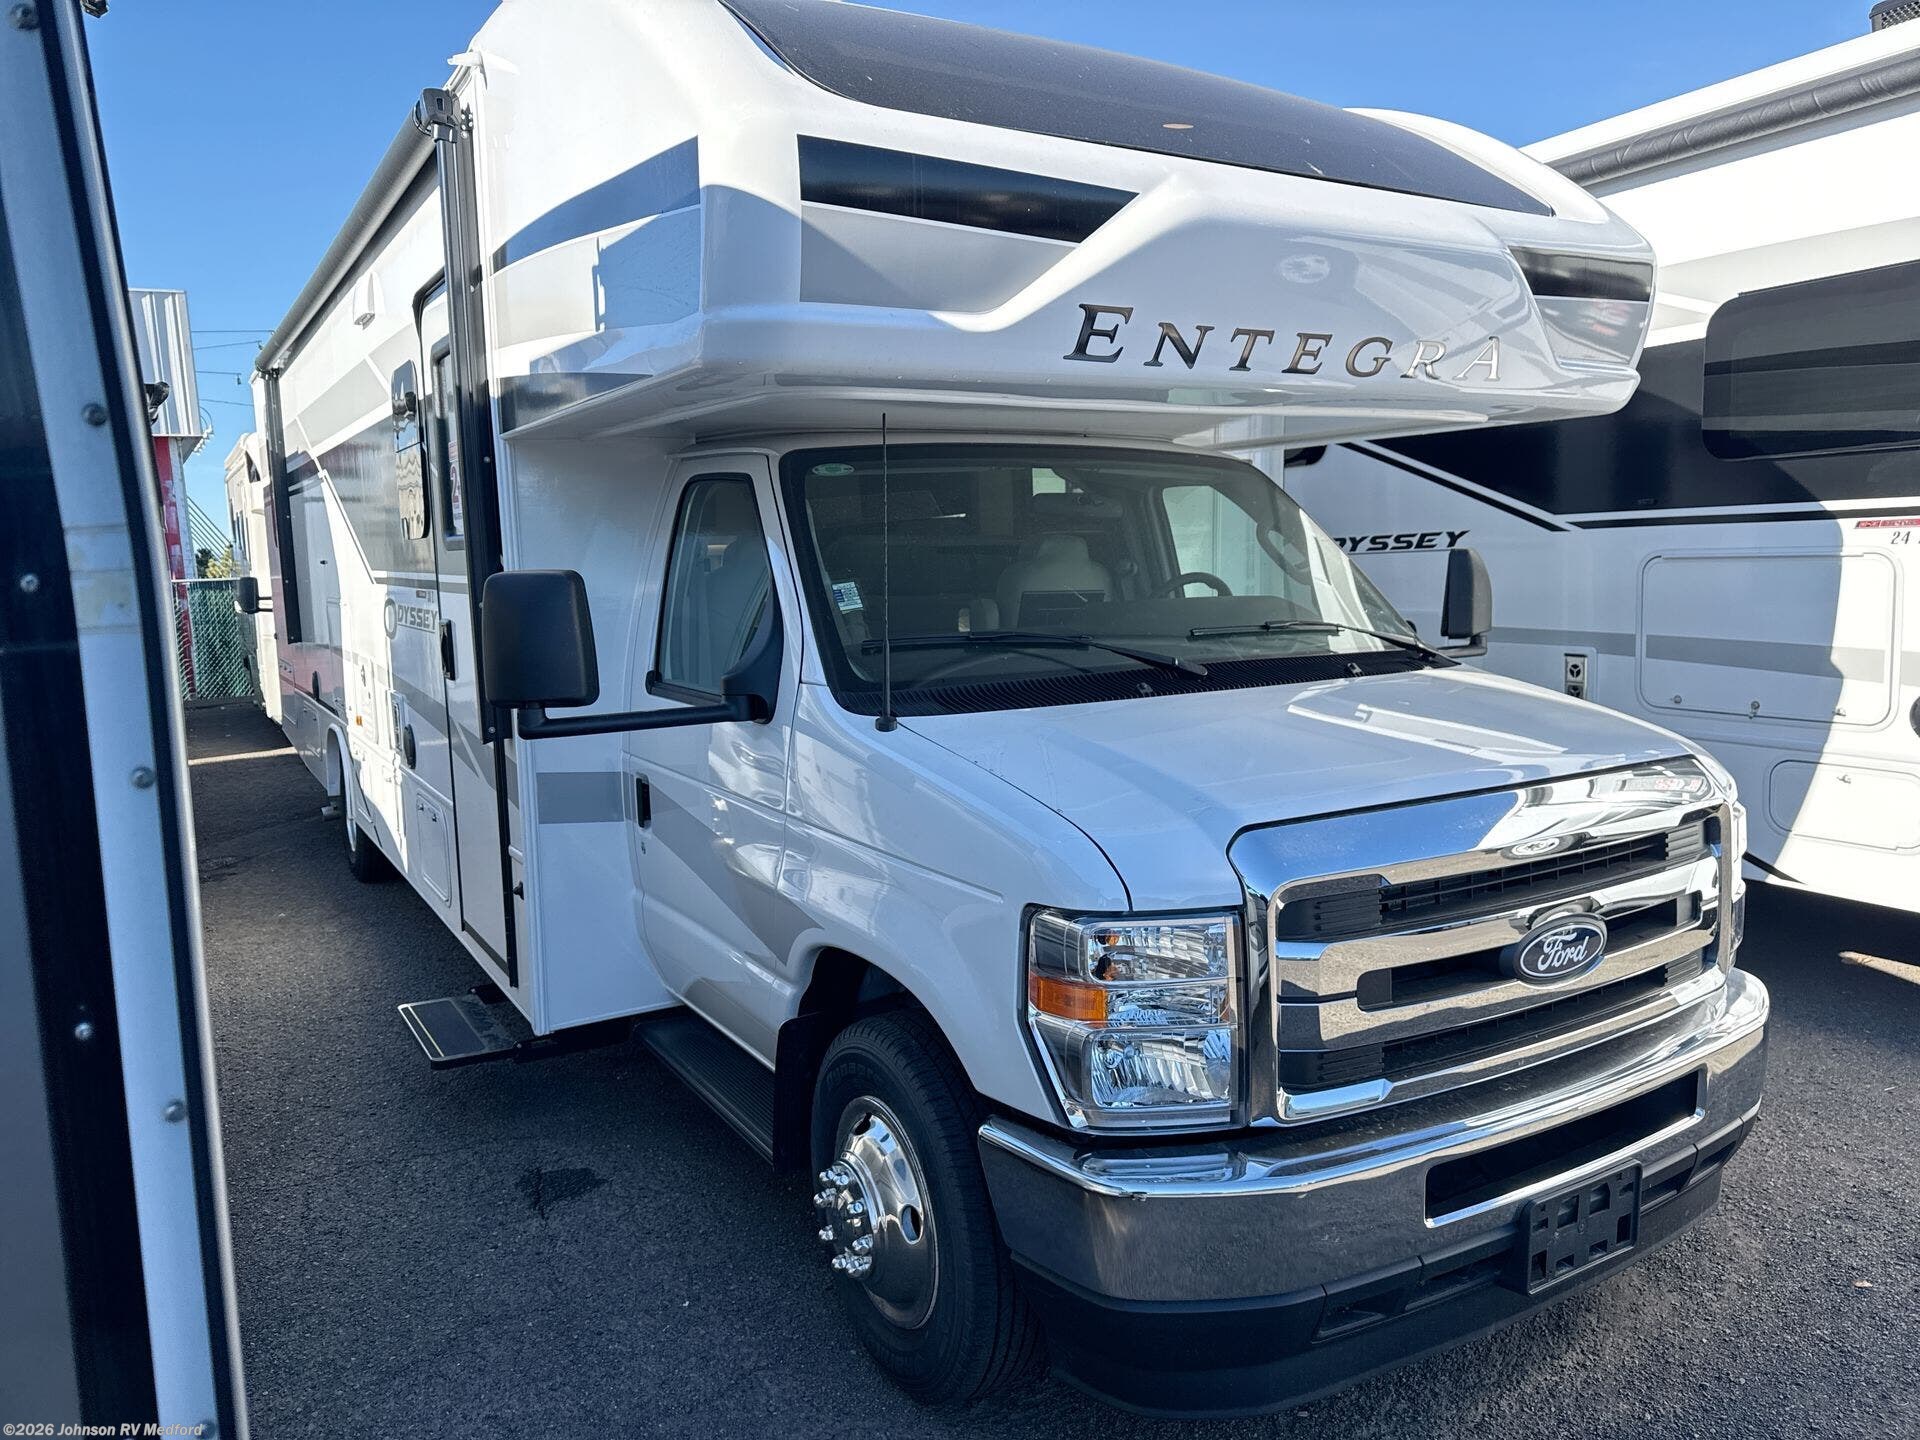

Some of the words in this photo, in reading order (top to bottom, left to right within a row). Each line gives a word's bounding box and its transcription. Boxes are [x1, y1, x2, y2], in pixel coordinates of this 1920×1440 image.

[1063, 303, 1501, 381] ENTEGRA
[1890, 531, 1911, 545] 24
[1538, 932, 1590, 971] Ford
